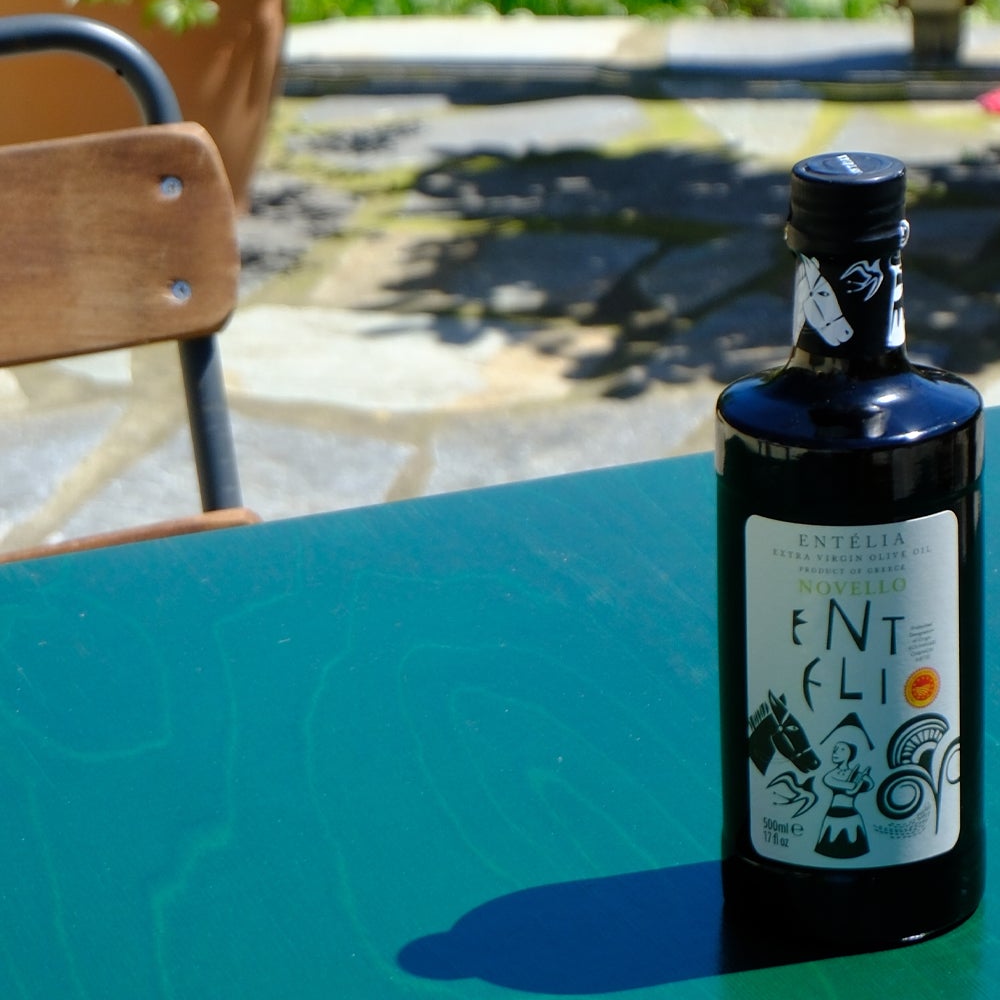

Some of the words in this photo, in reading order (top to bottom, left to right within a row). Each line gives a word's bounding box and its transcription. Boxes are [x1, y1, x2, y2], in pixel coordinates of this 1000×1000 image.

[799, 532, 905, 549] ENTÉLIA
[773, 548, 810, 560] EXTRA
[817, 554, 863, 563] VIRGIN
[869, 550, 907, 561] OLIVE
[912, 545, 932, 556] OIL
[799, 566, 845, 575] PRODUCT
[867, 564, 906, 575] GREECE
[798, 578, 907, 597] NOVELLO
[763, 816, 789, 834] 500ml
[763, 830, 772, 843] 17
[773, 832, 779, 845] fl
[780, 837, 790, 848] oz
